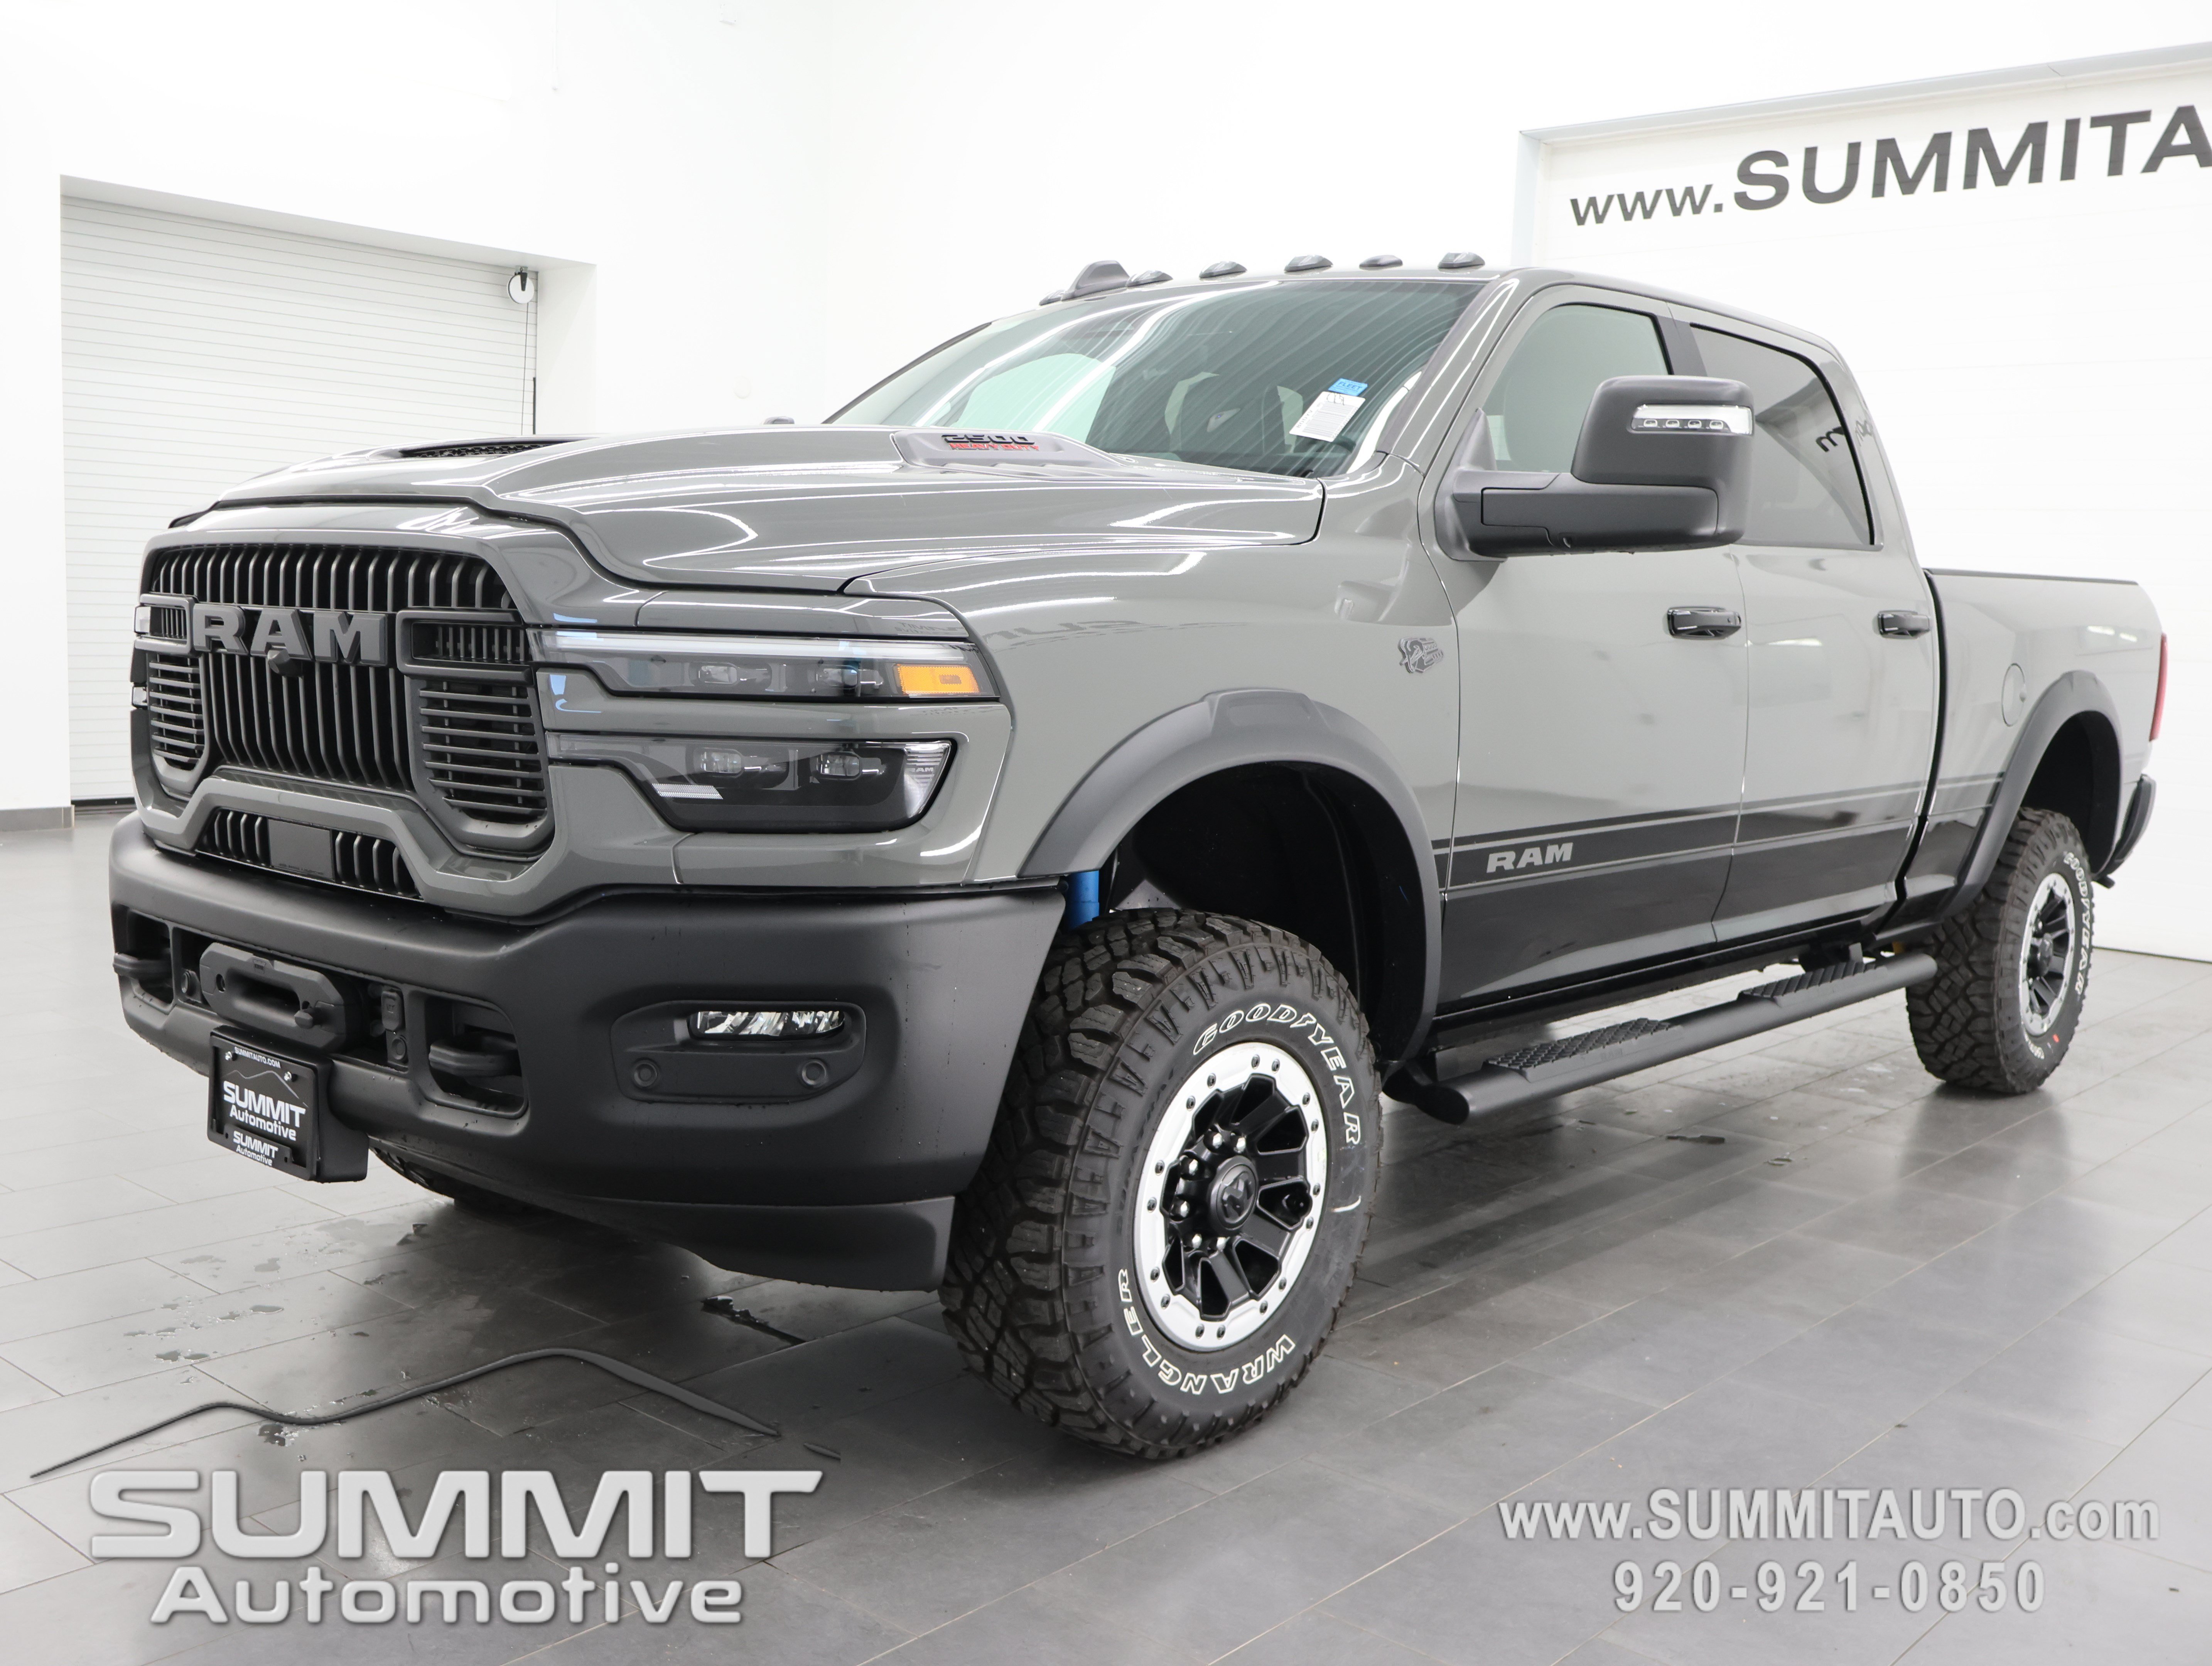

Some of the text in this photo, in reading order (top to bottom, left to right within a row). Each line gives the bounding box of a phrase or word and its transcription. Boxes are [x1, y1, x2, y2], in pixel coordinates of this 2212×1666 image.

[1570, 105, 2212, 227] www.SUMMITA
[1337, 381, 1363, 390] FLEET
[941, 434, 1035, 444] 2500
[193, 604, 387, 666] RAM
[1486, 842, 1573, 873] RAM
[235, 1046, 281, 1069] SUMMITAUTO.COM
[1193, 1003, 1361, 1145] GOODYEAR
[223, 1081, 306, 1128] SUMMIT
[229, 1105, 296, 1141] Automotive
[233, 1131, 278, 1158] SUMMIT
[236, 1144, 273, 1166] Automotive
[1118, 1268, 1296, 1395] WRANGLER
